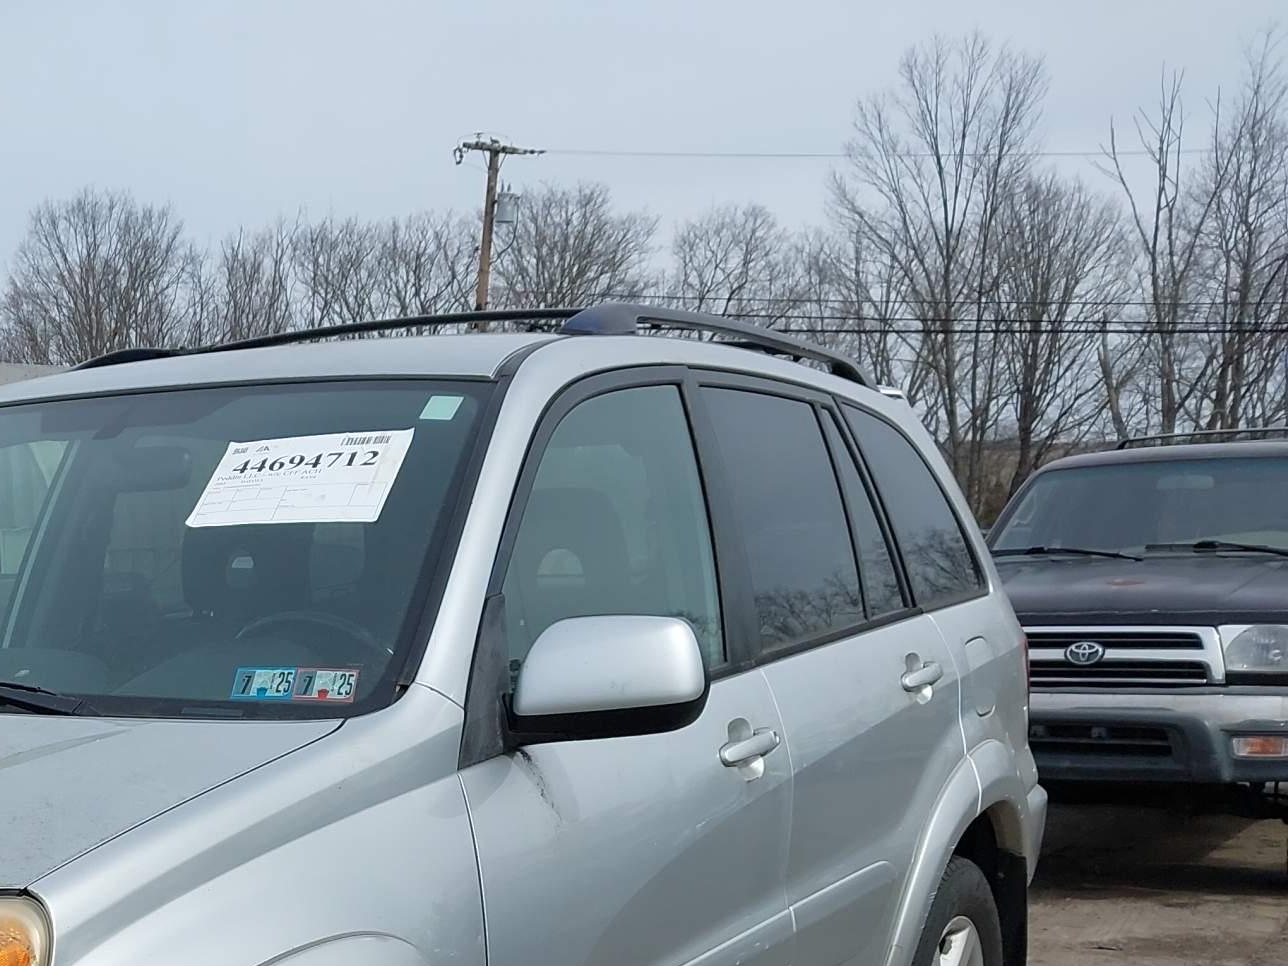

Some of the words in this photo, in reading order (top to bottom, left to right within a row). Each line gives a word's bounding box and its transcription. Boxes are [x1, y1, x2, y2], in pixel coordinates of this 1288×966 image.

[232, 450, 380, 474] 44694712
[240, 674, 252, 695] 7
[275, 671, 294, 693] 25
[303, 675, 313, 695] 7
[337, 673, 355, 696] 25
